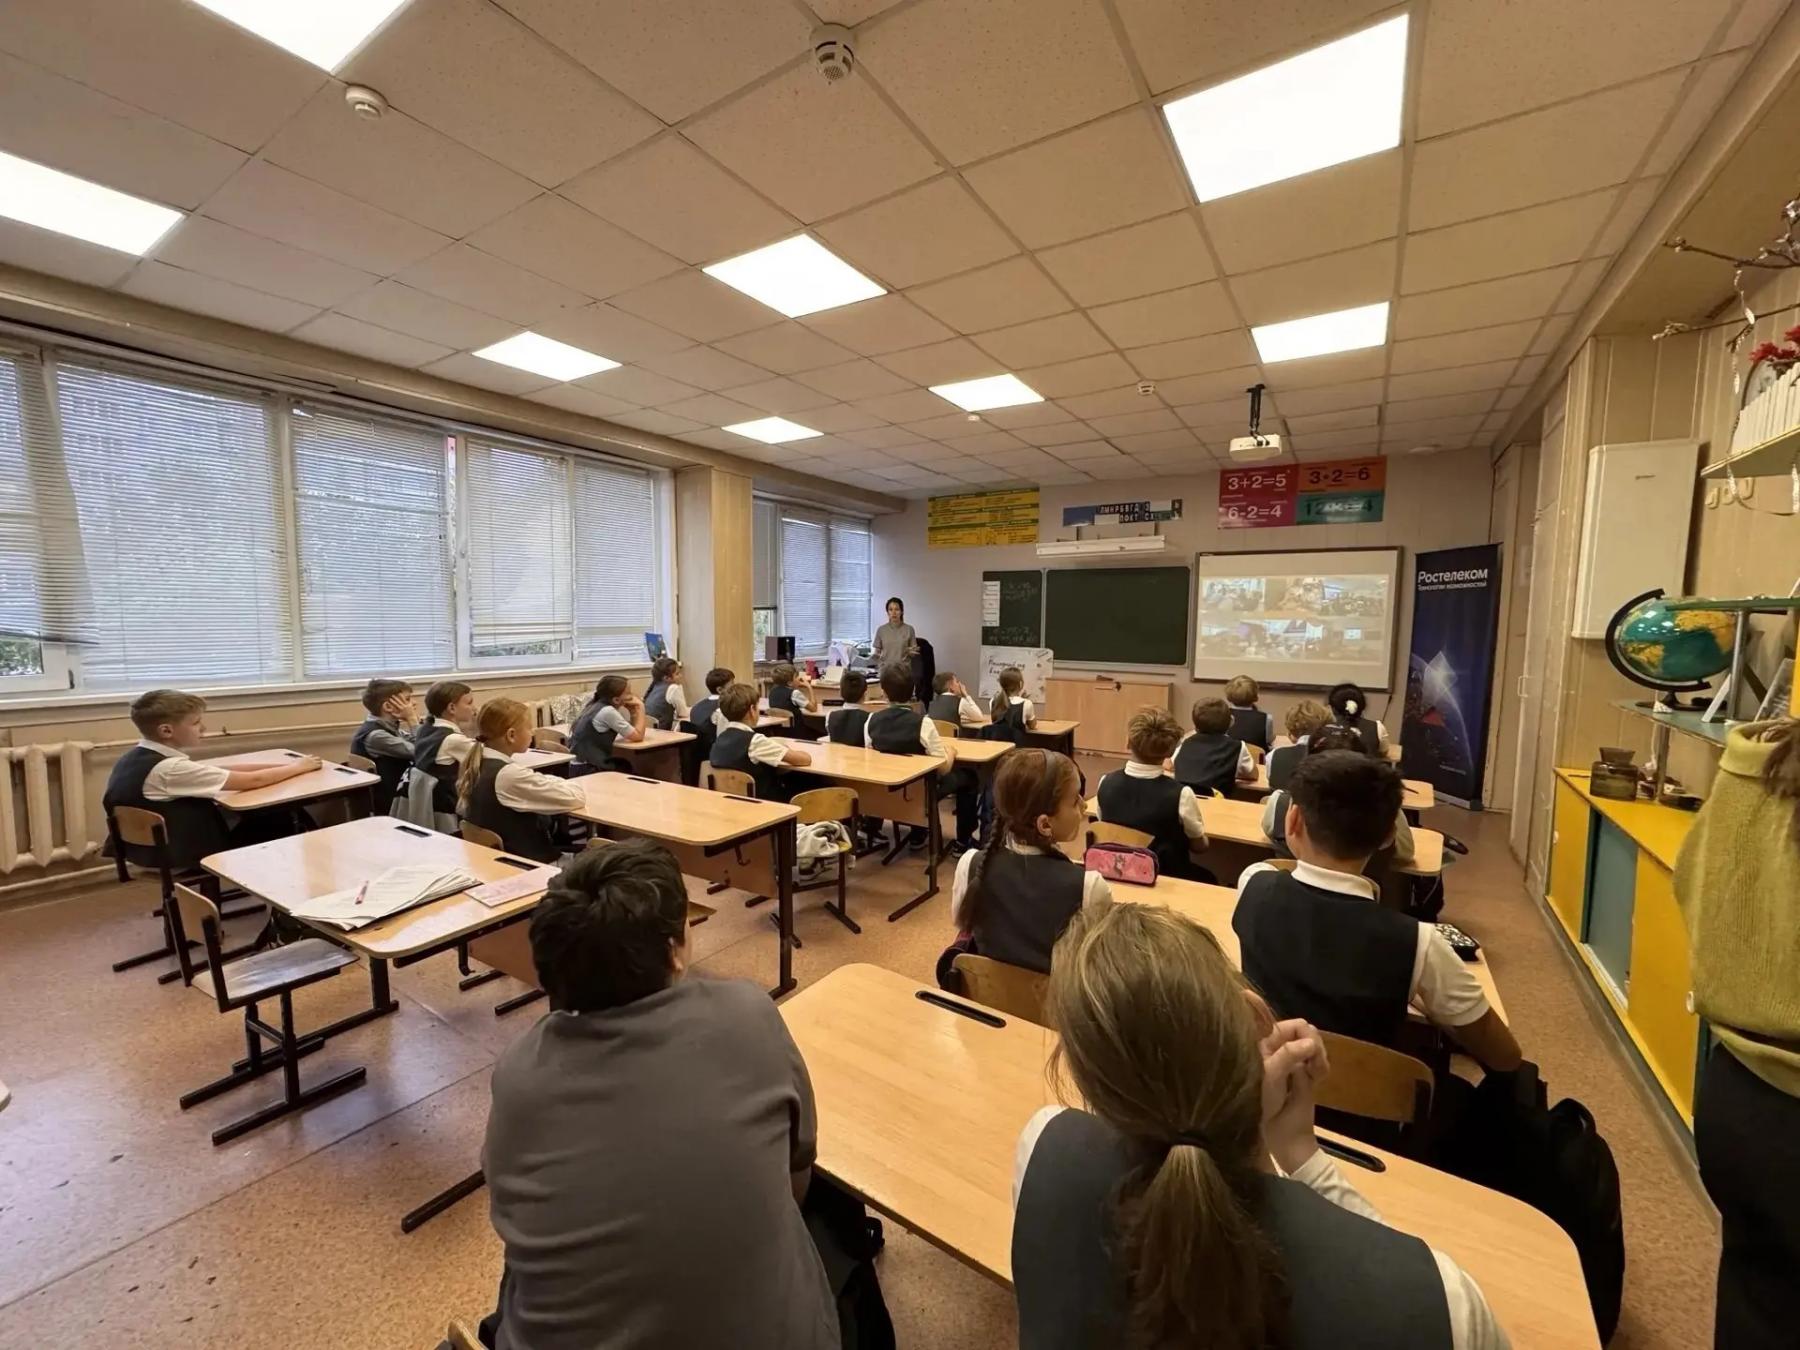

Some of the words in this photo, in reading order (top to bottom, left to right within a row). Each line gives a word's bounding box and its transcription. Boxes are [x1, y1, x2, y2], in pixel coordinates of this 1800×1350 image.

[1228, 474, 1287, 490] 3+2=5
[1228, 504, 1282, 520] 6-2=4
[1418, 568, 1488, 583] Ростелеком
